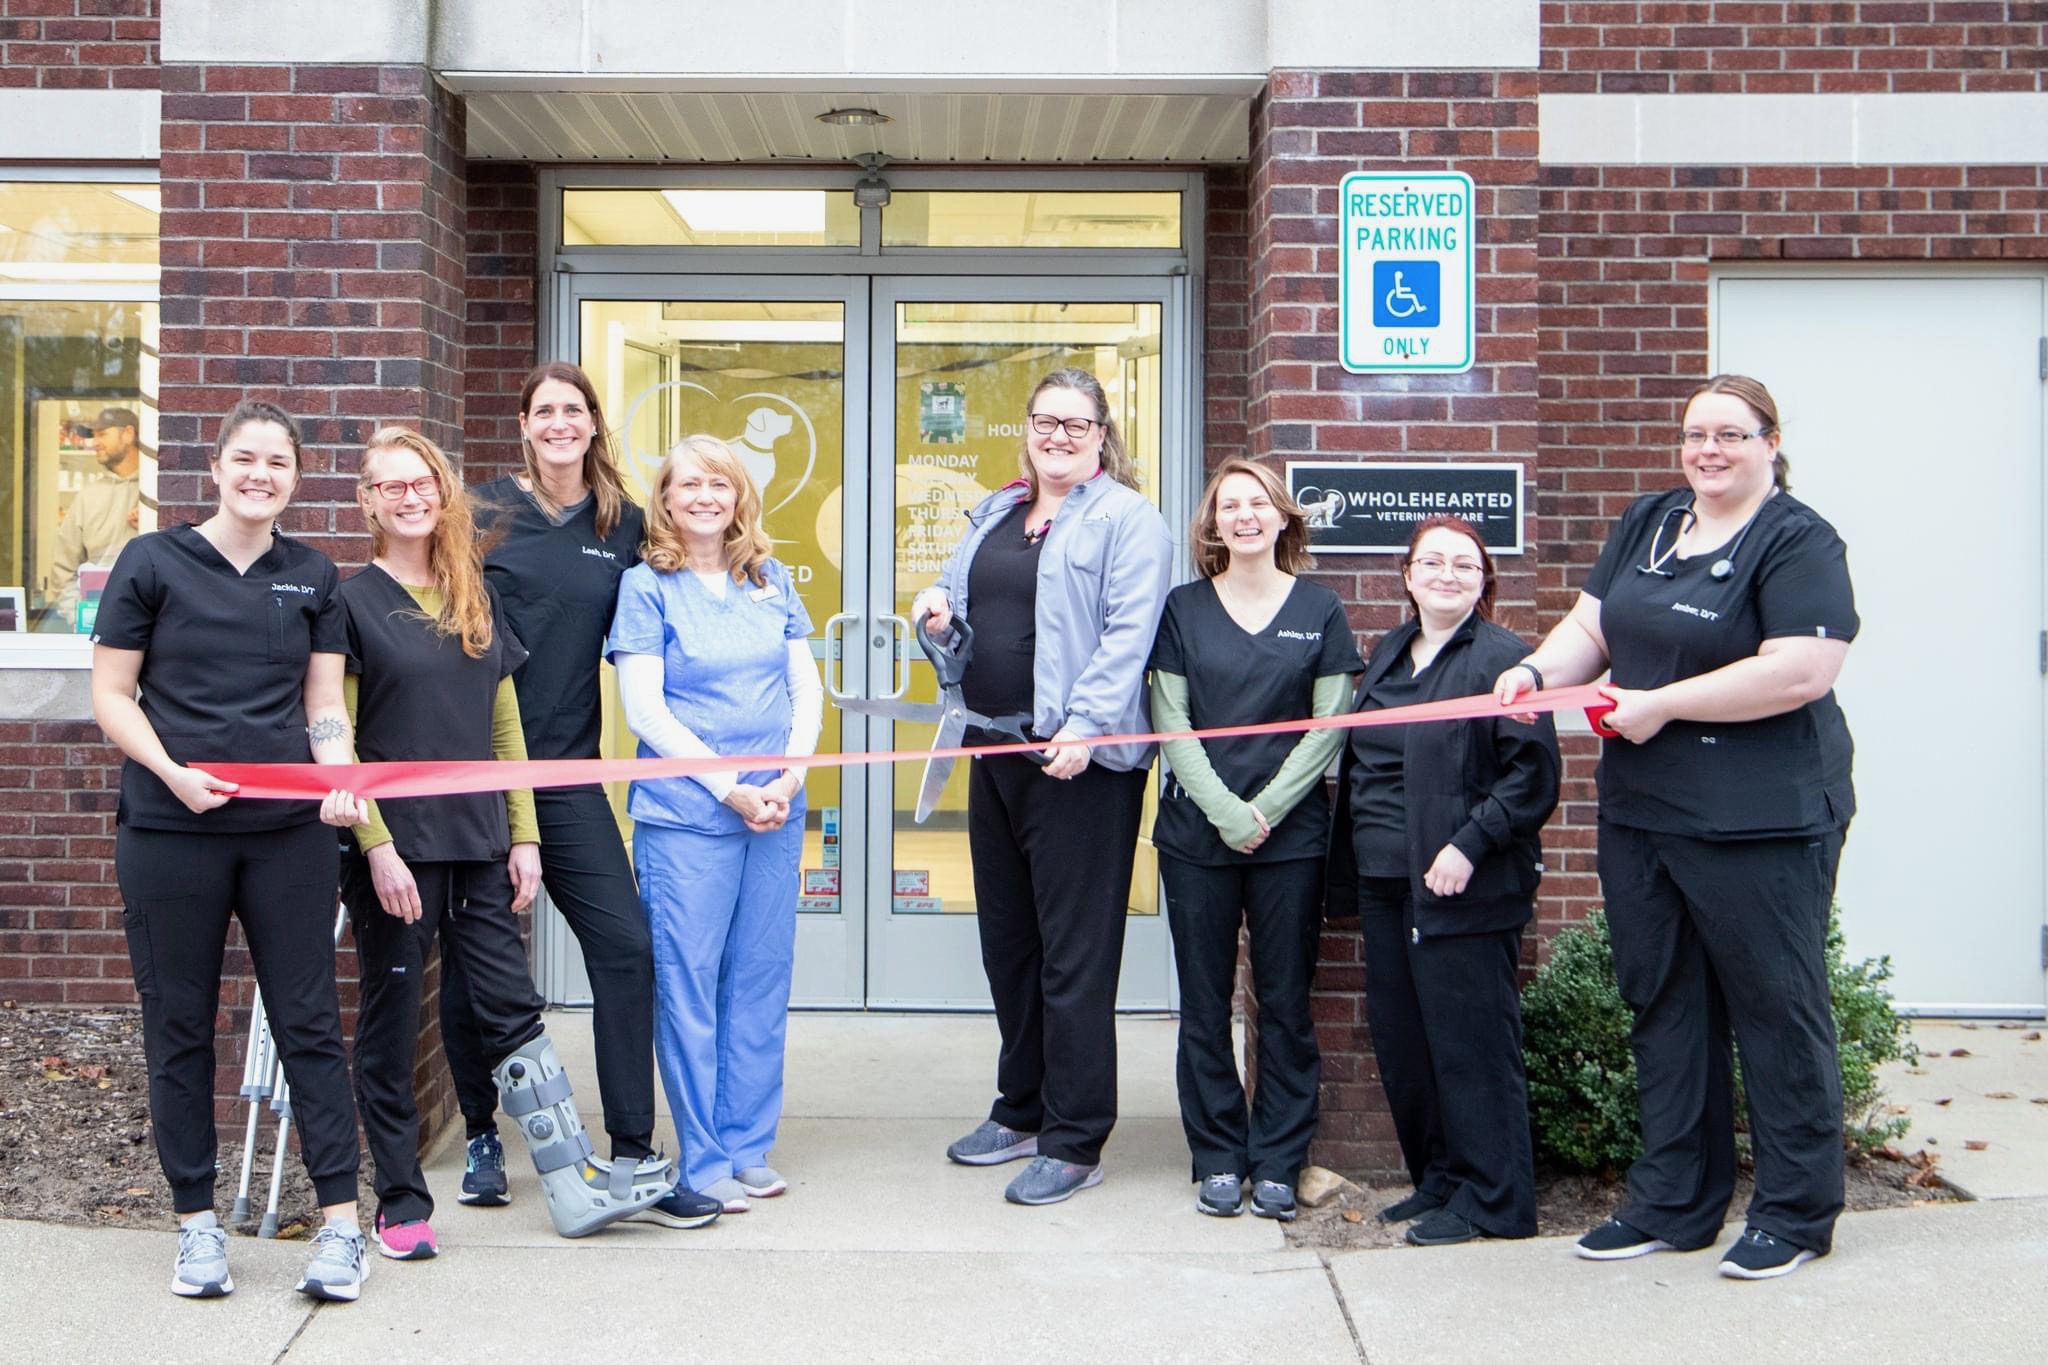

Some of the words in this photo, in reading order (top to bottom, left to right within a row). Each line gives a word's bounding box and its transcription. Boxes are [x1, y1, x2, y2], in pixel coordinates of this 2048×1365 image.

[1351, 193, 1463, 217] RESERVED
[1357, 227, 1457, 250] PARKING
[1383, 337, 1430, 356] ONLY
[987, 424, 1028, 437] HOU
[908, 454, 978, 467] MONDAY
[1348, 491, 1513, 508] WHOLEHEARTED
[907, 525, 960, 538] FRIDAY
[907, 560, 942, 572] SUN
